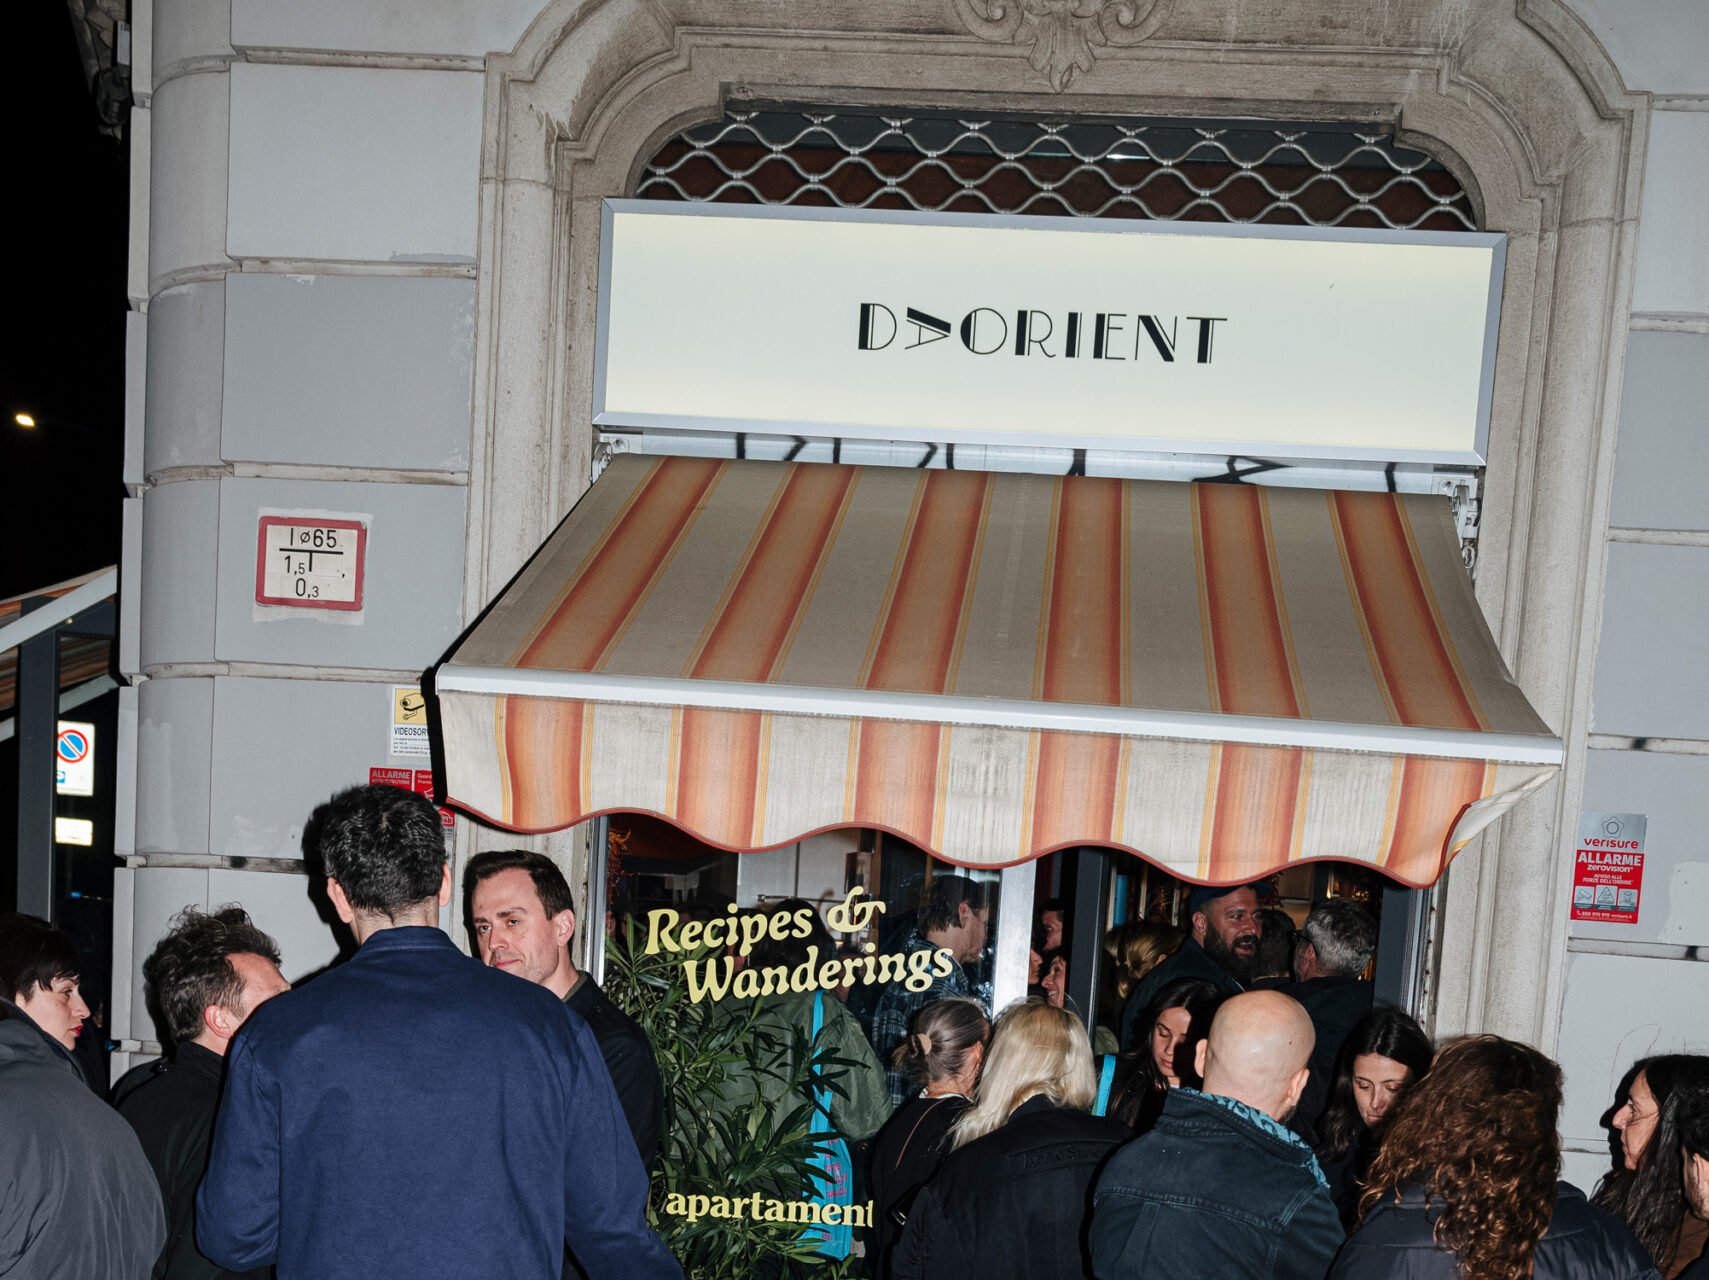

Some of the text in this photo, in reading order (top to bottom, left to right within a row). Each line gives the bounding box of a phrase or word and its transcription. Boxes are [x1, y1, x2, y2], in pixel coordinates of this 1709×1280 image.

[284, 554, 306, 576] 1,5
[295, 578, 319, 599] 0,3
[393, 727, 428, 736] VIDEOSOR
[371, 769, 411, 779] ALLARME
[1584, 838, 1638, 849] verisure
[1578, 852, 1642, 866] ALLARME
[644, 885, 886, 956] Recipes &
[682, 943, 955, 1004] Wanderings
